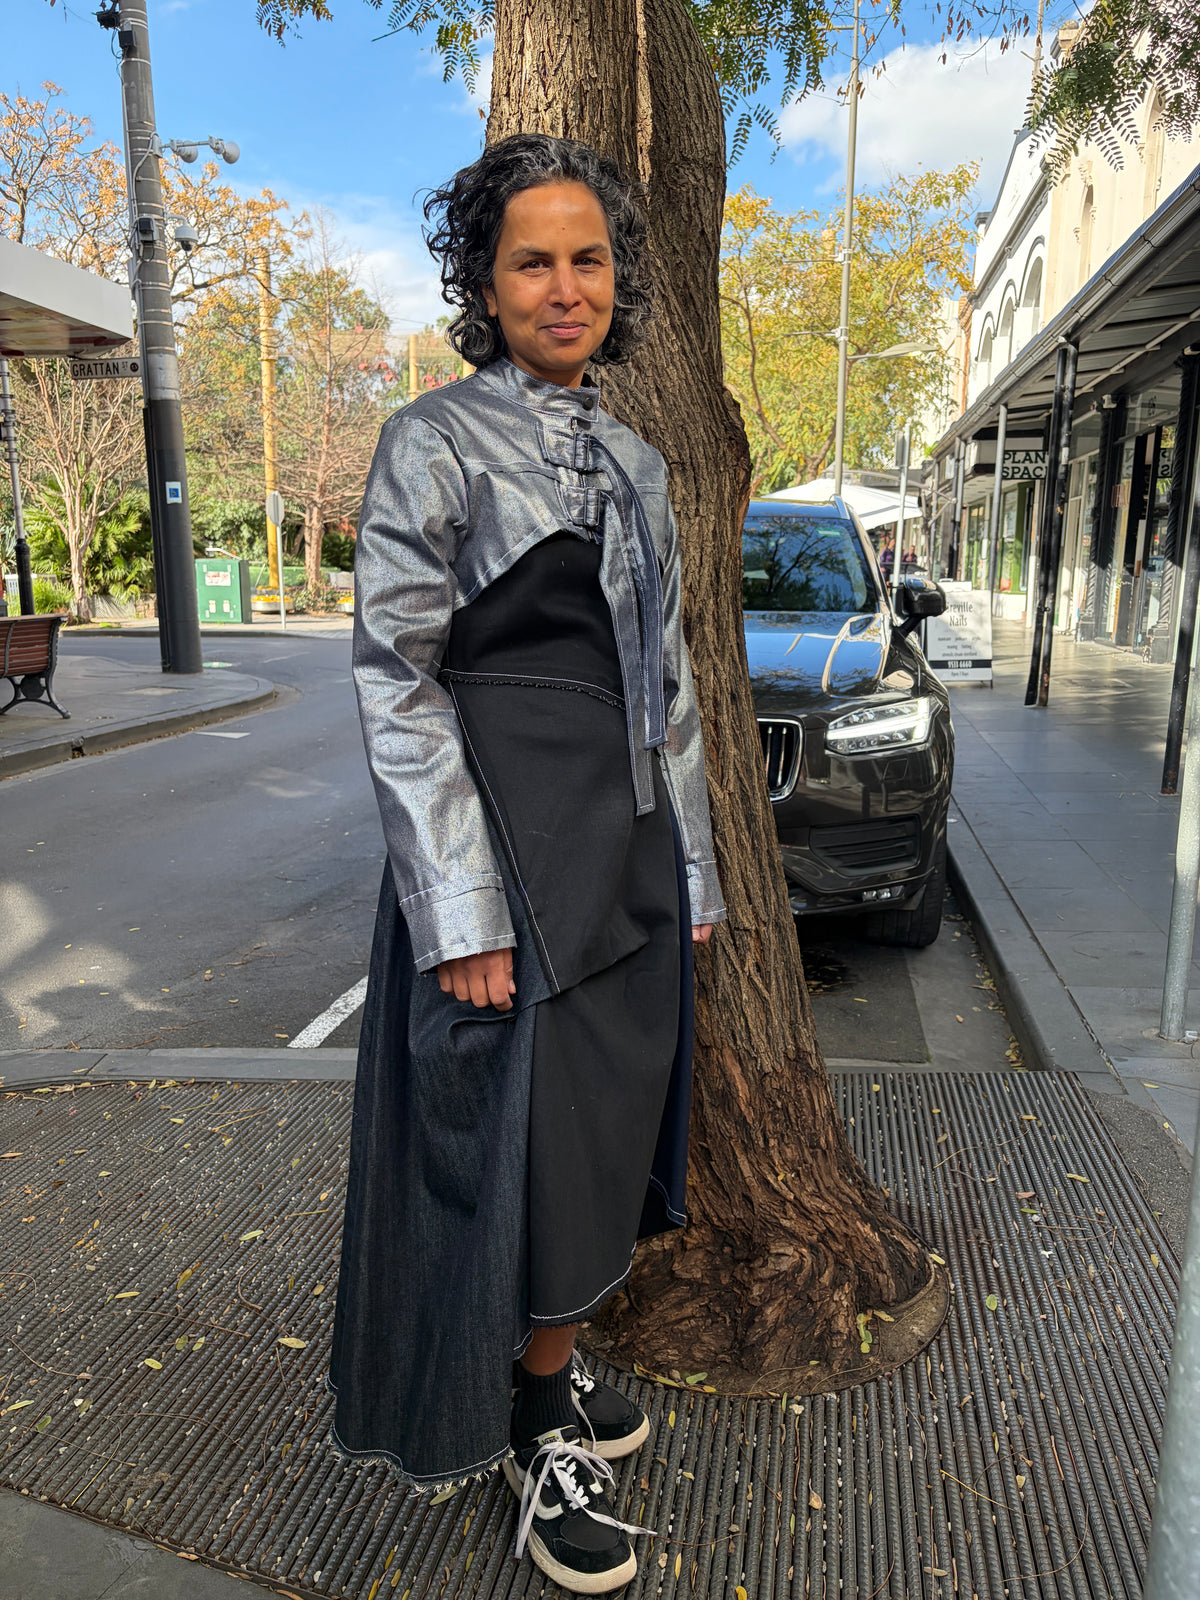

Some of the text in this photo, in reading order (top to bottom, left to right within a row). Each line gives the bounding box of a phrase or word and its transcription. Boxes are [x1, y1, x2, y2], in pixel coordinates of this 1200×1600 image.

[72, 361, 128, 376] GRATTAN ST
[1002, 451, 1048, 464] PLAN
[1001, 466, 1048, 478] SPAC
